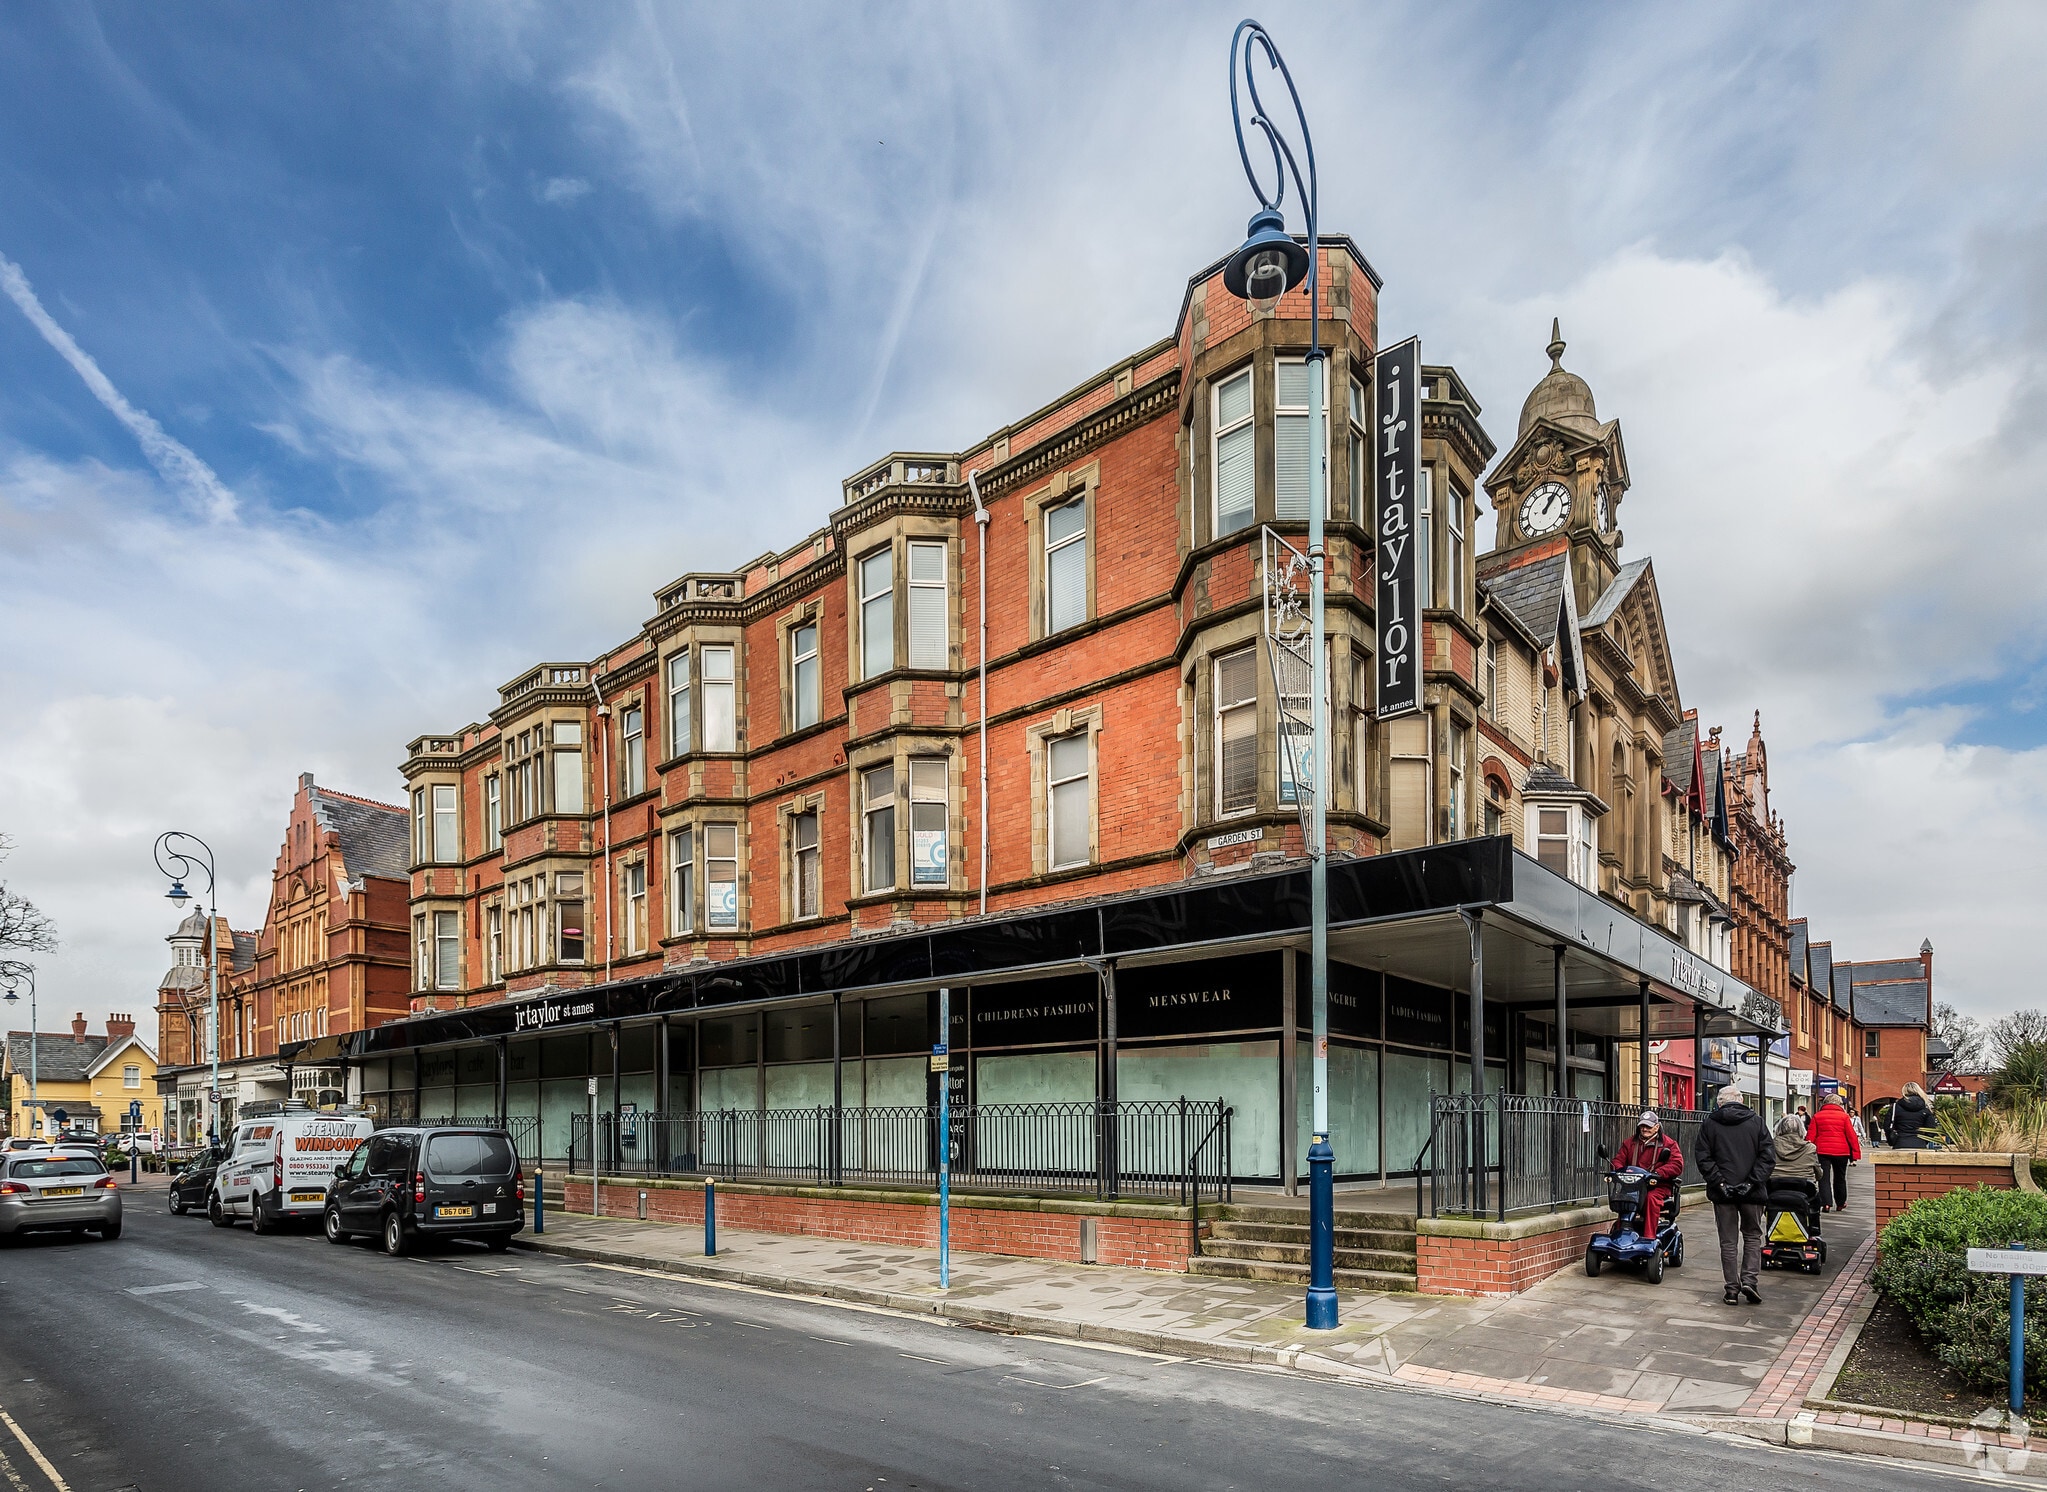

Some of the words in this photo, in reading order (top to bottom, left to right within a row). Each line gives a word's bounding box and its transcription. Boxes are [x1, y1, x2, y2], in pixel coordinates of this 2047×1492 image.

[1380, 705, 1388, 713] st
[1390, 699, 1413, 711] annes
[1217, 832, 1247, 845] GARDEN
[1250, 830, 1261, 839] ST
[1149, 989, 1231, 1007] MENSWEAR
[1328, 992, 1357, 1008] NGERIE
[563, 1004, 571, 1017] st
[571, 1003, 594, 1016] annes
[977, 1007, 1039, 1022] CHILDRENS
[1044, 1002, 1094, 1017] FASHION
[1391, 1005, 1415, 1019] LADIES
[949, 1014, 964, 1025] OES
[949, 1077, 965, 1089] tter
[950, 1095, 964, 1103] VEL
[302, 1122, 357, 1137] STEAMY
[295, 1137, 363, 1151] WINDOWS
[440, 1208, 457, 1216] LB67
[2001, 1253, 2033, 1261] loading
